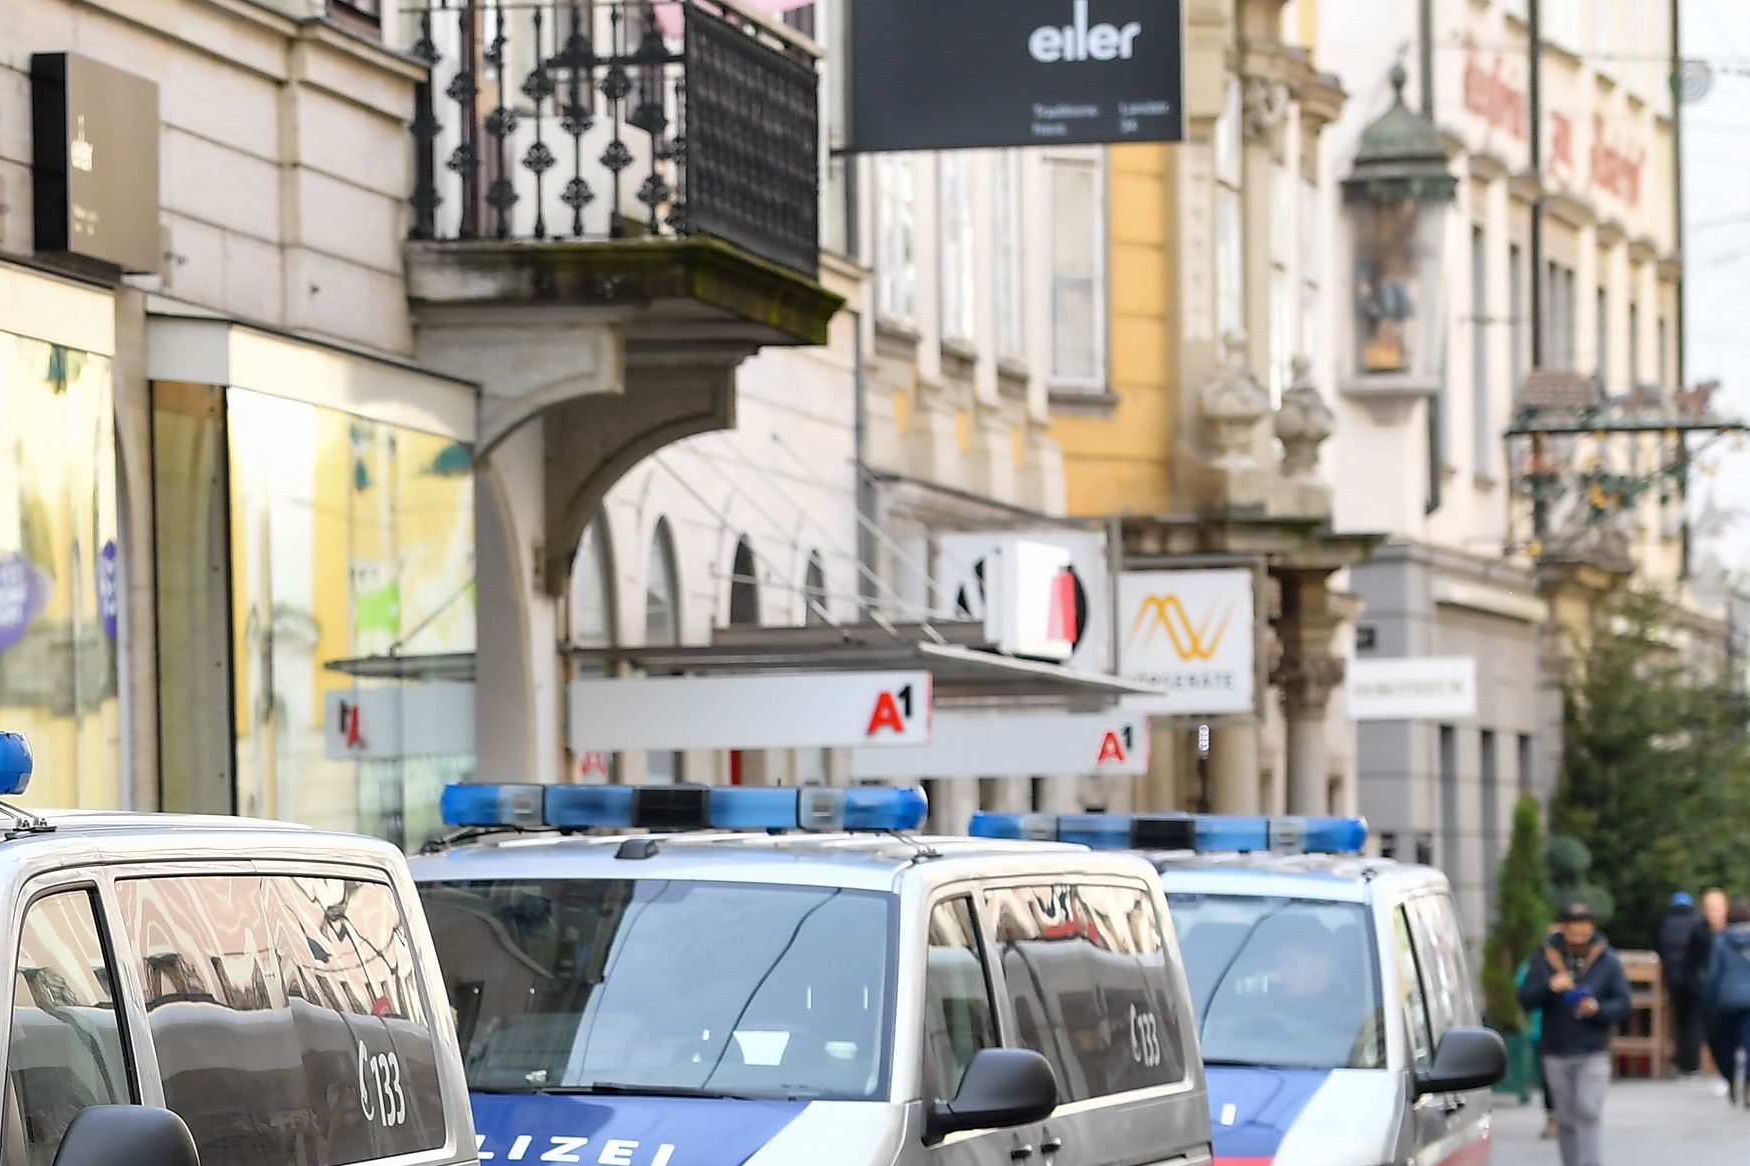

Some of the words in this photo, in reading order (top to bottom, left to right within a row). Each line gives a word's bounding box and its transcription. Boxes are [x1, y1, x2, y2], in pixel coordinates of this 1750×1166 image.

[865, 680, 914, 736] A1
[1096, 725, 1133, 765] A1
[1137, 1012, 1161, 1068] 133
[370, 1051, 406, 1127] 133
